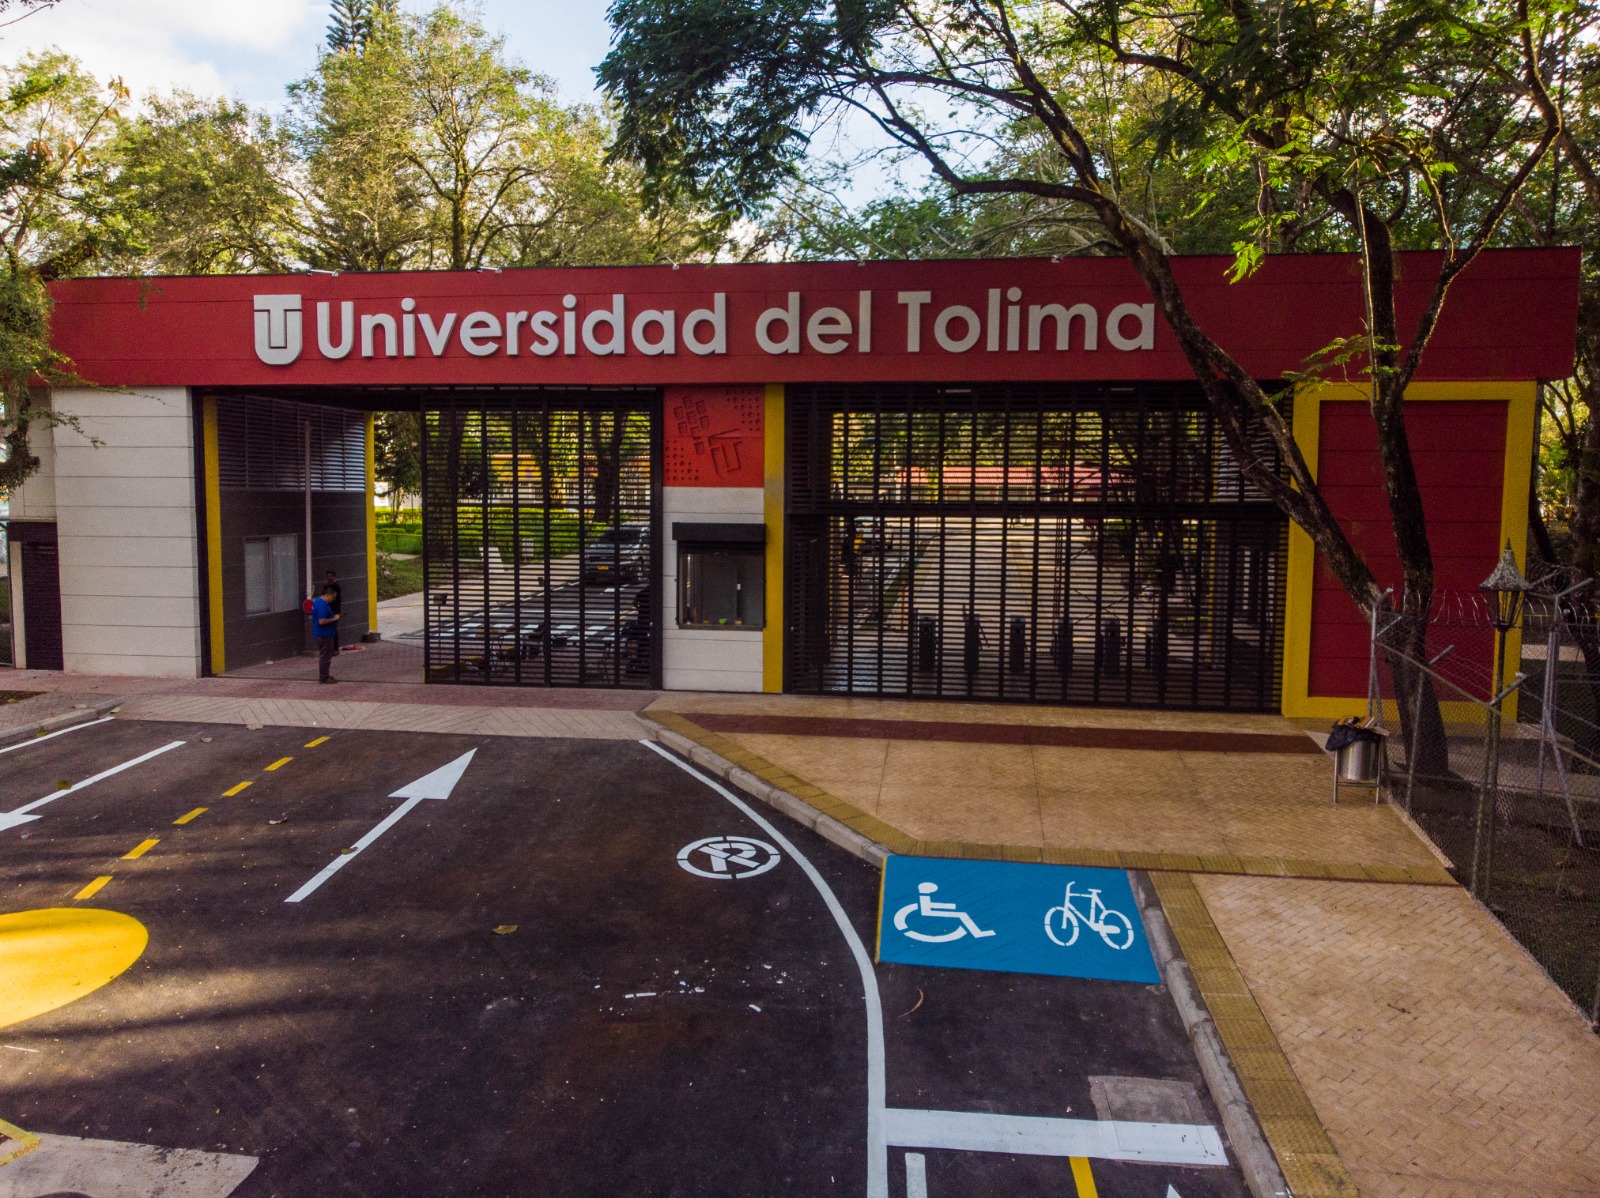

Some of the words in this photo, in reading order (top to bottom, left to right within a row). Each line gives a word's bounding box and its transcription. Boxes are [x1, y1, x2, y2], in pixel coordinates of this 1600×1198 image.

[316, 292, 727, 359] Universidad
[755, 290, 872, 354] del
[898, 286, 1156, 353] Tolima
